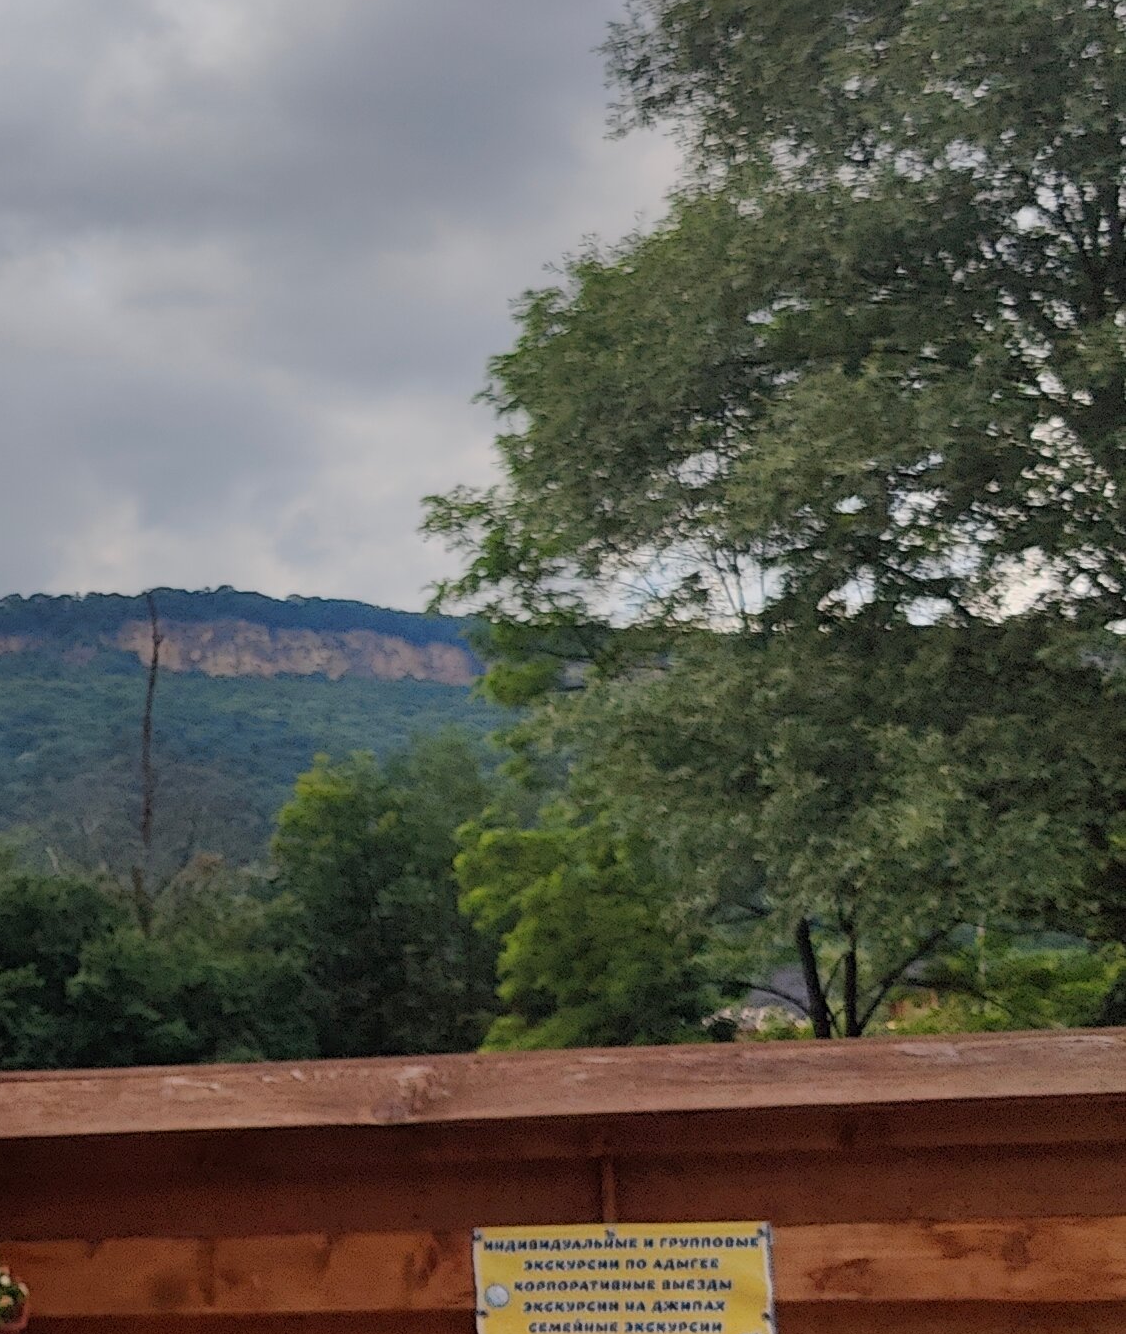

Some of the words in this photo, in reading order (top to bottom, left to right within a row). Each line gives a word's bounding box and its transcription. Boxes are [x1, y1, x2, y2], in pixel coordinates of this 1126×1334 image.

[484, 1237, 638, 1253] ИНДИВИДУАЛЬНЫЕ
[643, 1237, 653, 1249] И
[659, 1236, 759, 1249] ГРУППОВЫЕ
[523, 1258, 620, 1271] ЭКСКУРСИИ
[625, 1258, 648, 1270] ПО
[652, 1258, 720, 1272] АДЫГЕЕ
[514, 1279, 656, 1292] КОРПОРАТИВНЫЕ
[661, 1279, 732, 1293] ВЫЕЗДЫ
[522, 1300, 620, 1313] ЭКСКУРСИИ
[624, 1300, 646, 1312] НА
[651, 1299, 726, 1314] ДЖИПАХ
[528, 1318, 618, 1333] СЕМЕЙНЫЕ
[624, 1321, 723, 1333] ЭКСКУРСИИ
